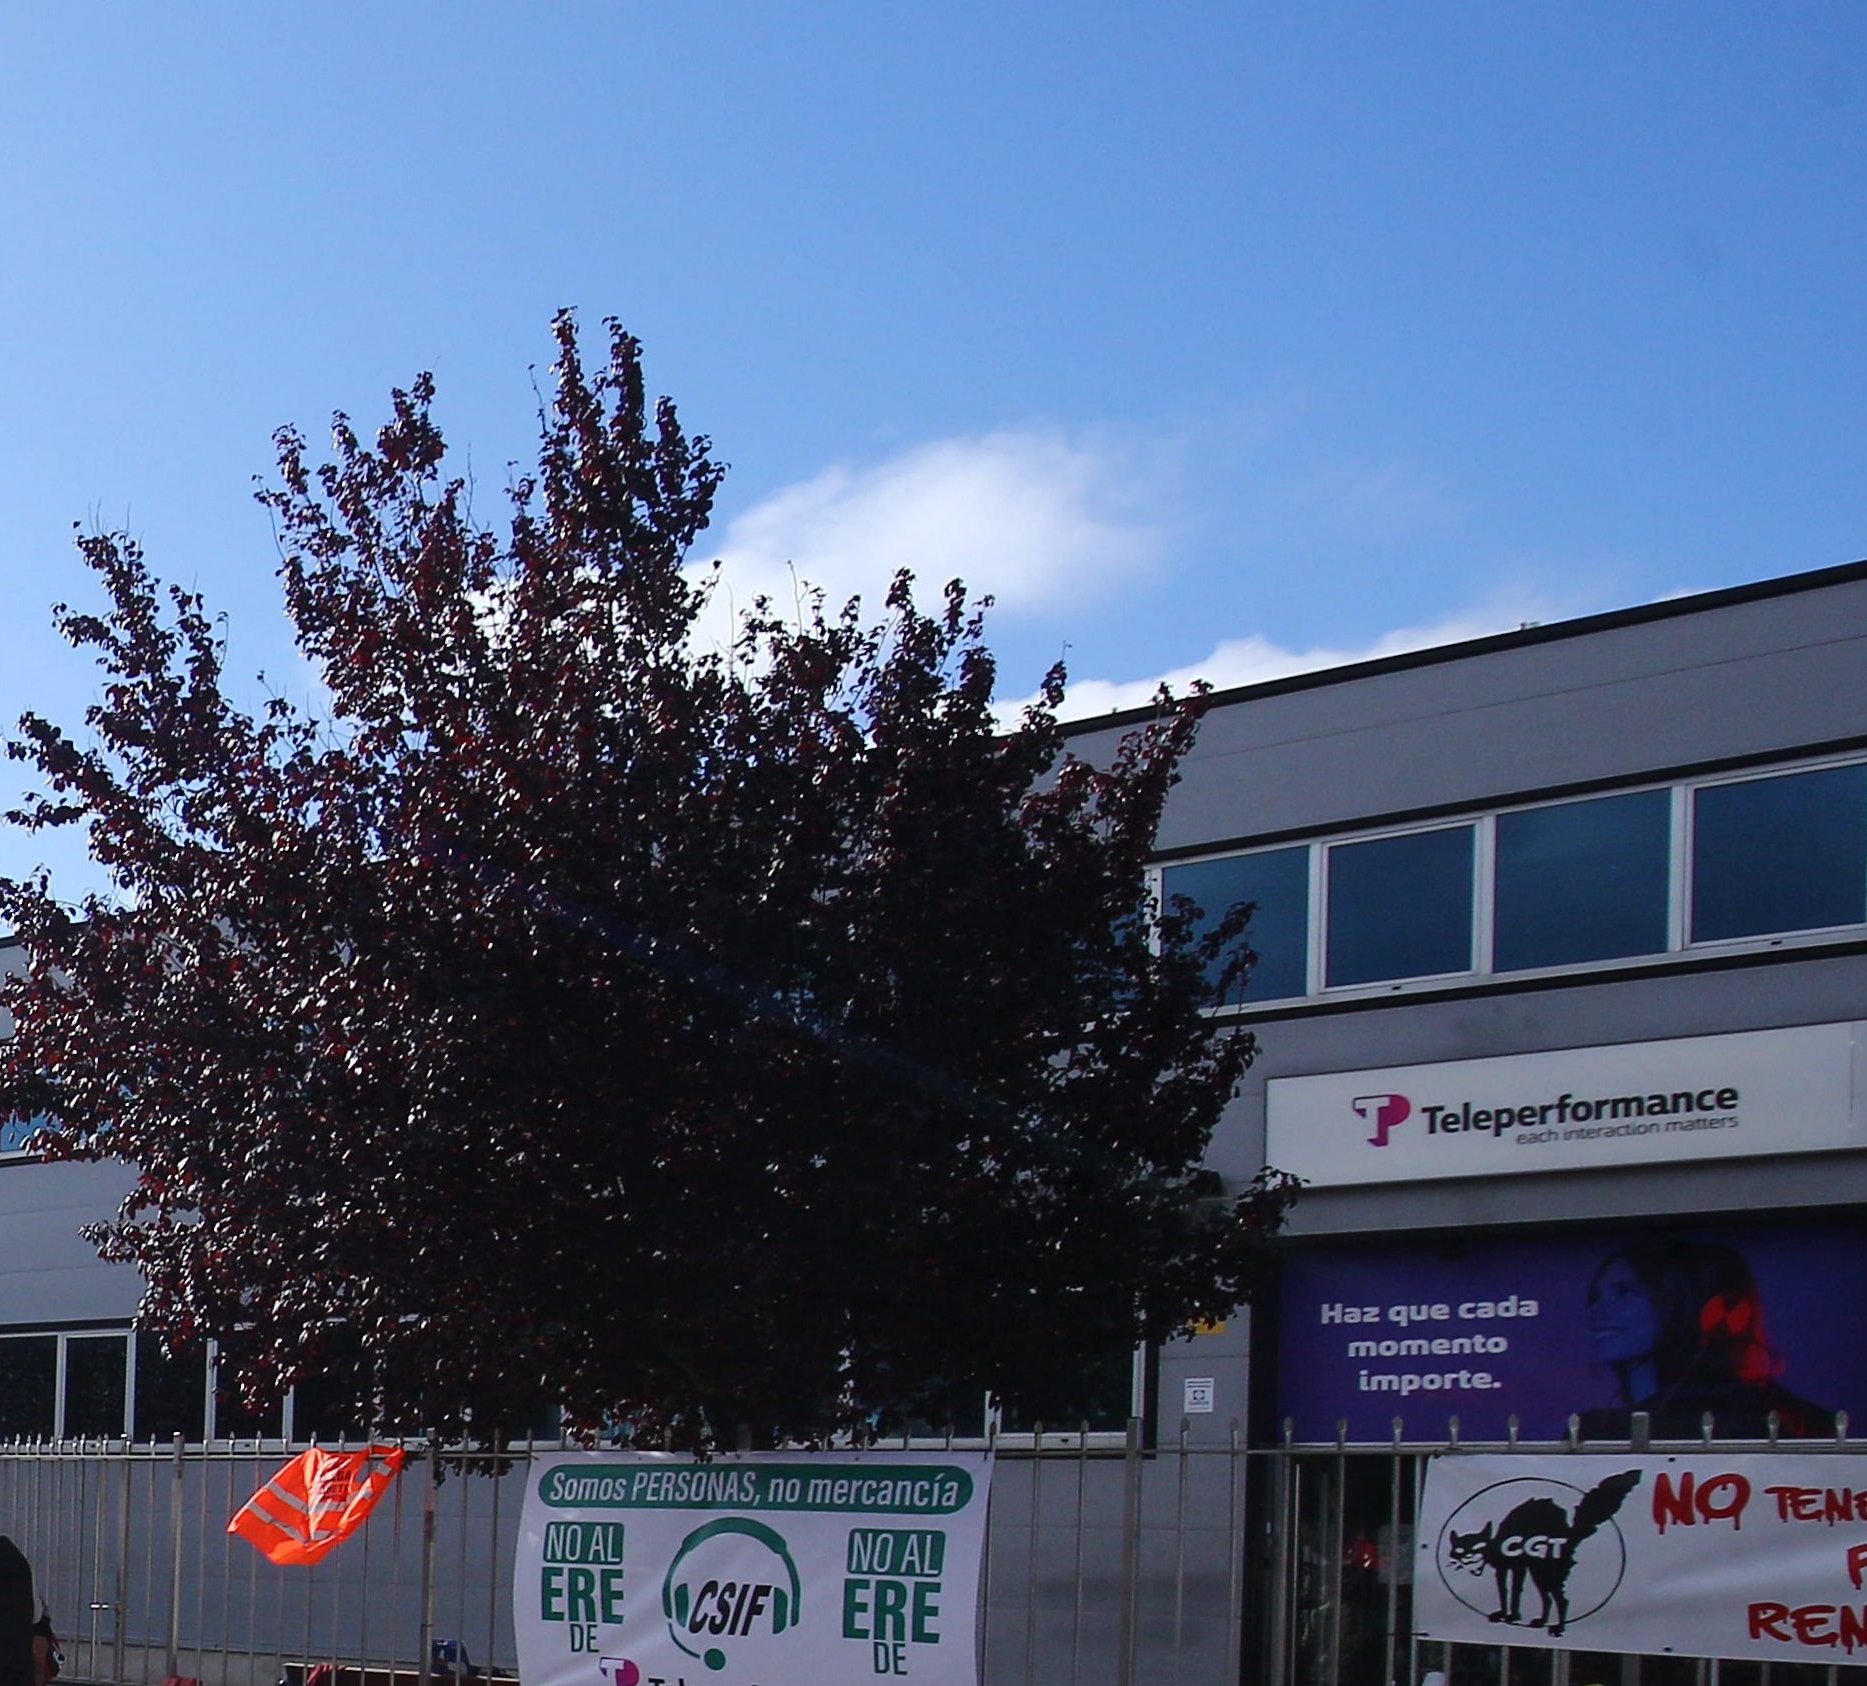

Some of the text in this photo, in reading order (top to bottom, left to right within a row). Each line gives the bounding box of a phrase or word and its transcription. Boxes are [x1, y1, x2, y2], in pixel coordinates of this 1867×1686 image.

[1421, 1087, 1739, 1138] Teleperformance
[1516, 1115, 1740, 1145] each interaction matters
[1321, 1295, 1539, 1327] Haz que cada
[1347, 1334, 1508, 1357] momento
[1359, 1370, 1502, 1396] importe.
[549, 1471, 960, 1507] Somos PERSONAS, no mercancía
[1652, 1471, 1751, 1535] NO
[545, 1524, 621, 1563] NO AL
[850, 1531, 940, 1575] NO AL
[1500, 1535, 1568, 1559] CGT
[541, 1566, 625, 1625] ERE
[688, 1579, 773, 1637] CSIF
[842, 1578, 942, 1644] ERE
[569, 1623, 601, 1654] DE
[873, 1641, 908, 1676] DE
